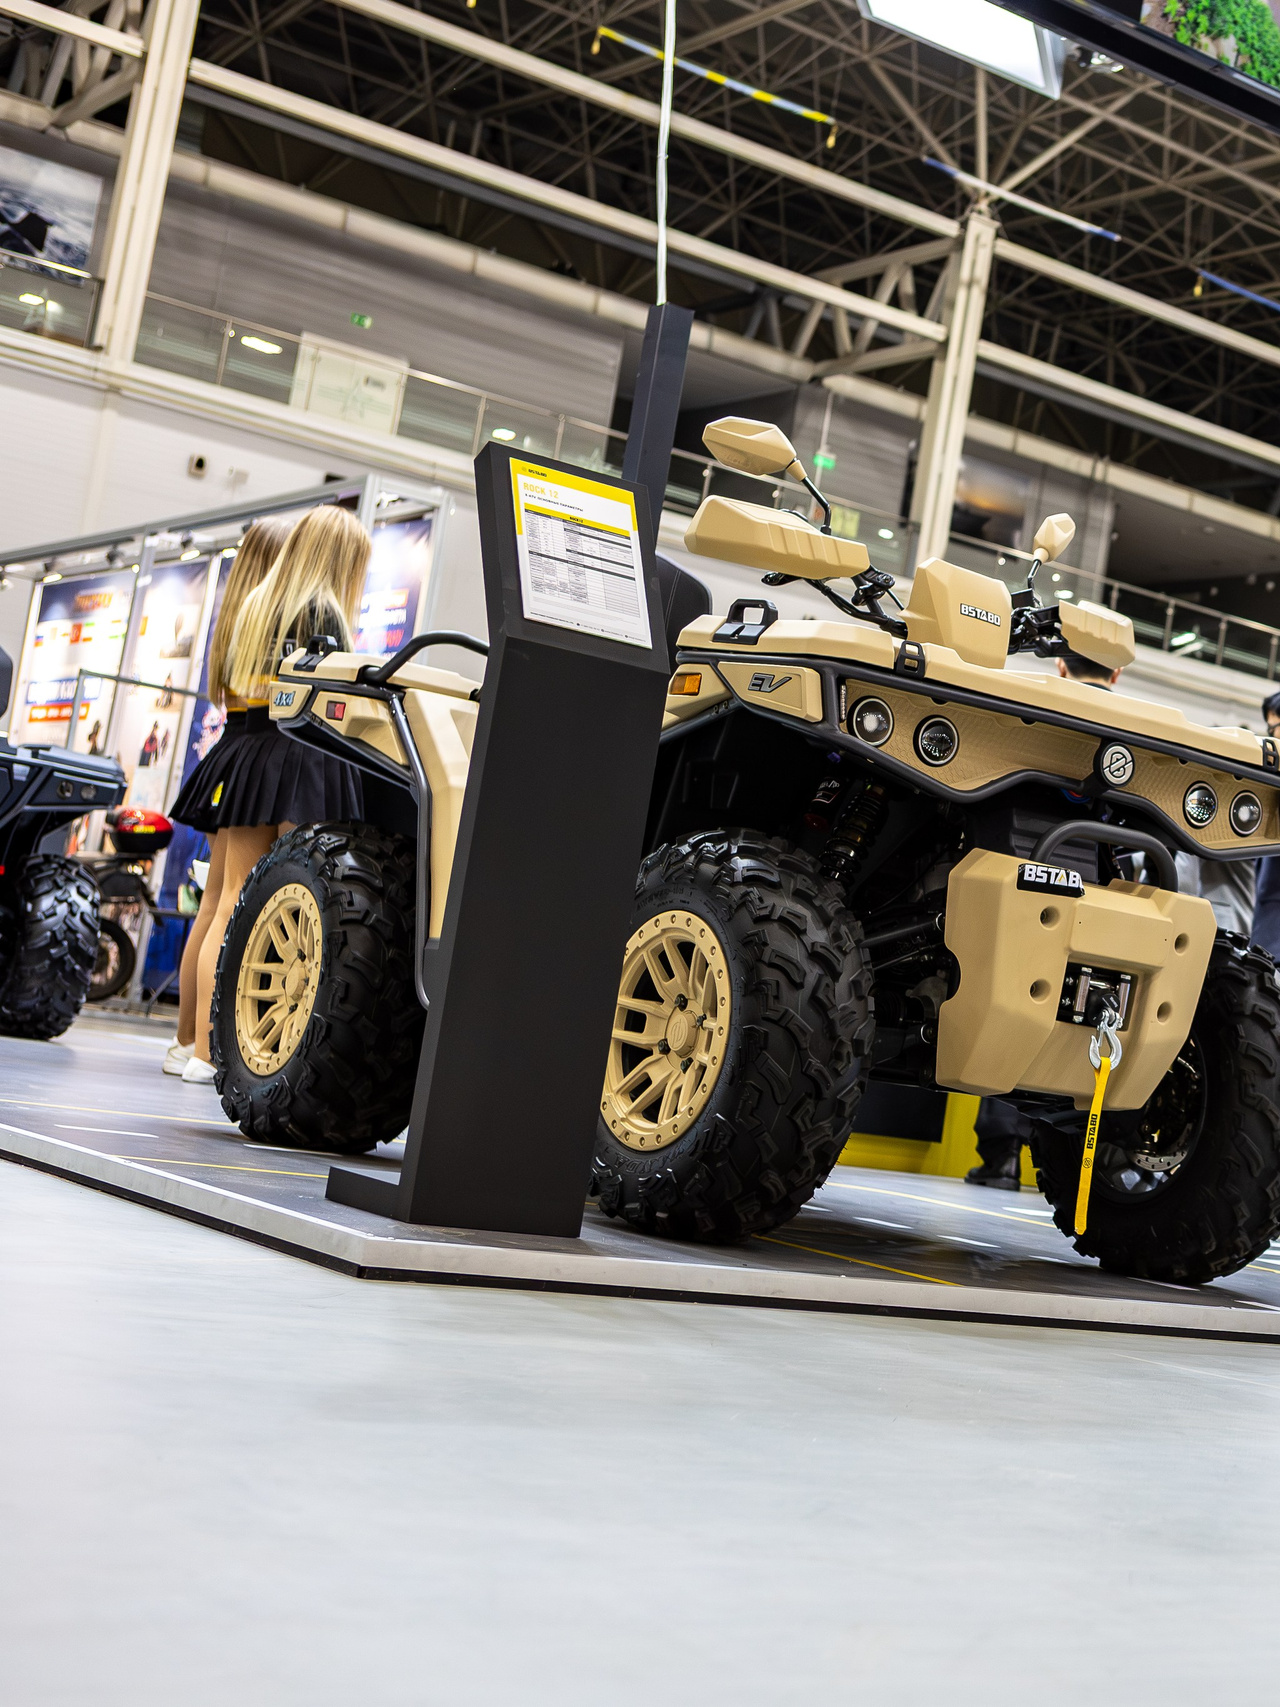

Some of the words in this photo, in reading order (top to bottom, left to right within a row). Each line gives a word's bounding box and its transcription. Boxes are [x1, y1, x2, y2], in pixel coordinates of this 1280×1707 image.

[523, 482, 546, 495] ROCK
[549, 489, 559, 499] 12
[960, 602, 1001, 626] BSTABO
[748, 672, 792, 693] EV
[1024, 864, 1085, 889] BSTAB
[1086, 1113, 1098, 1149] BSTABO
